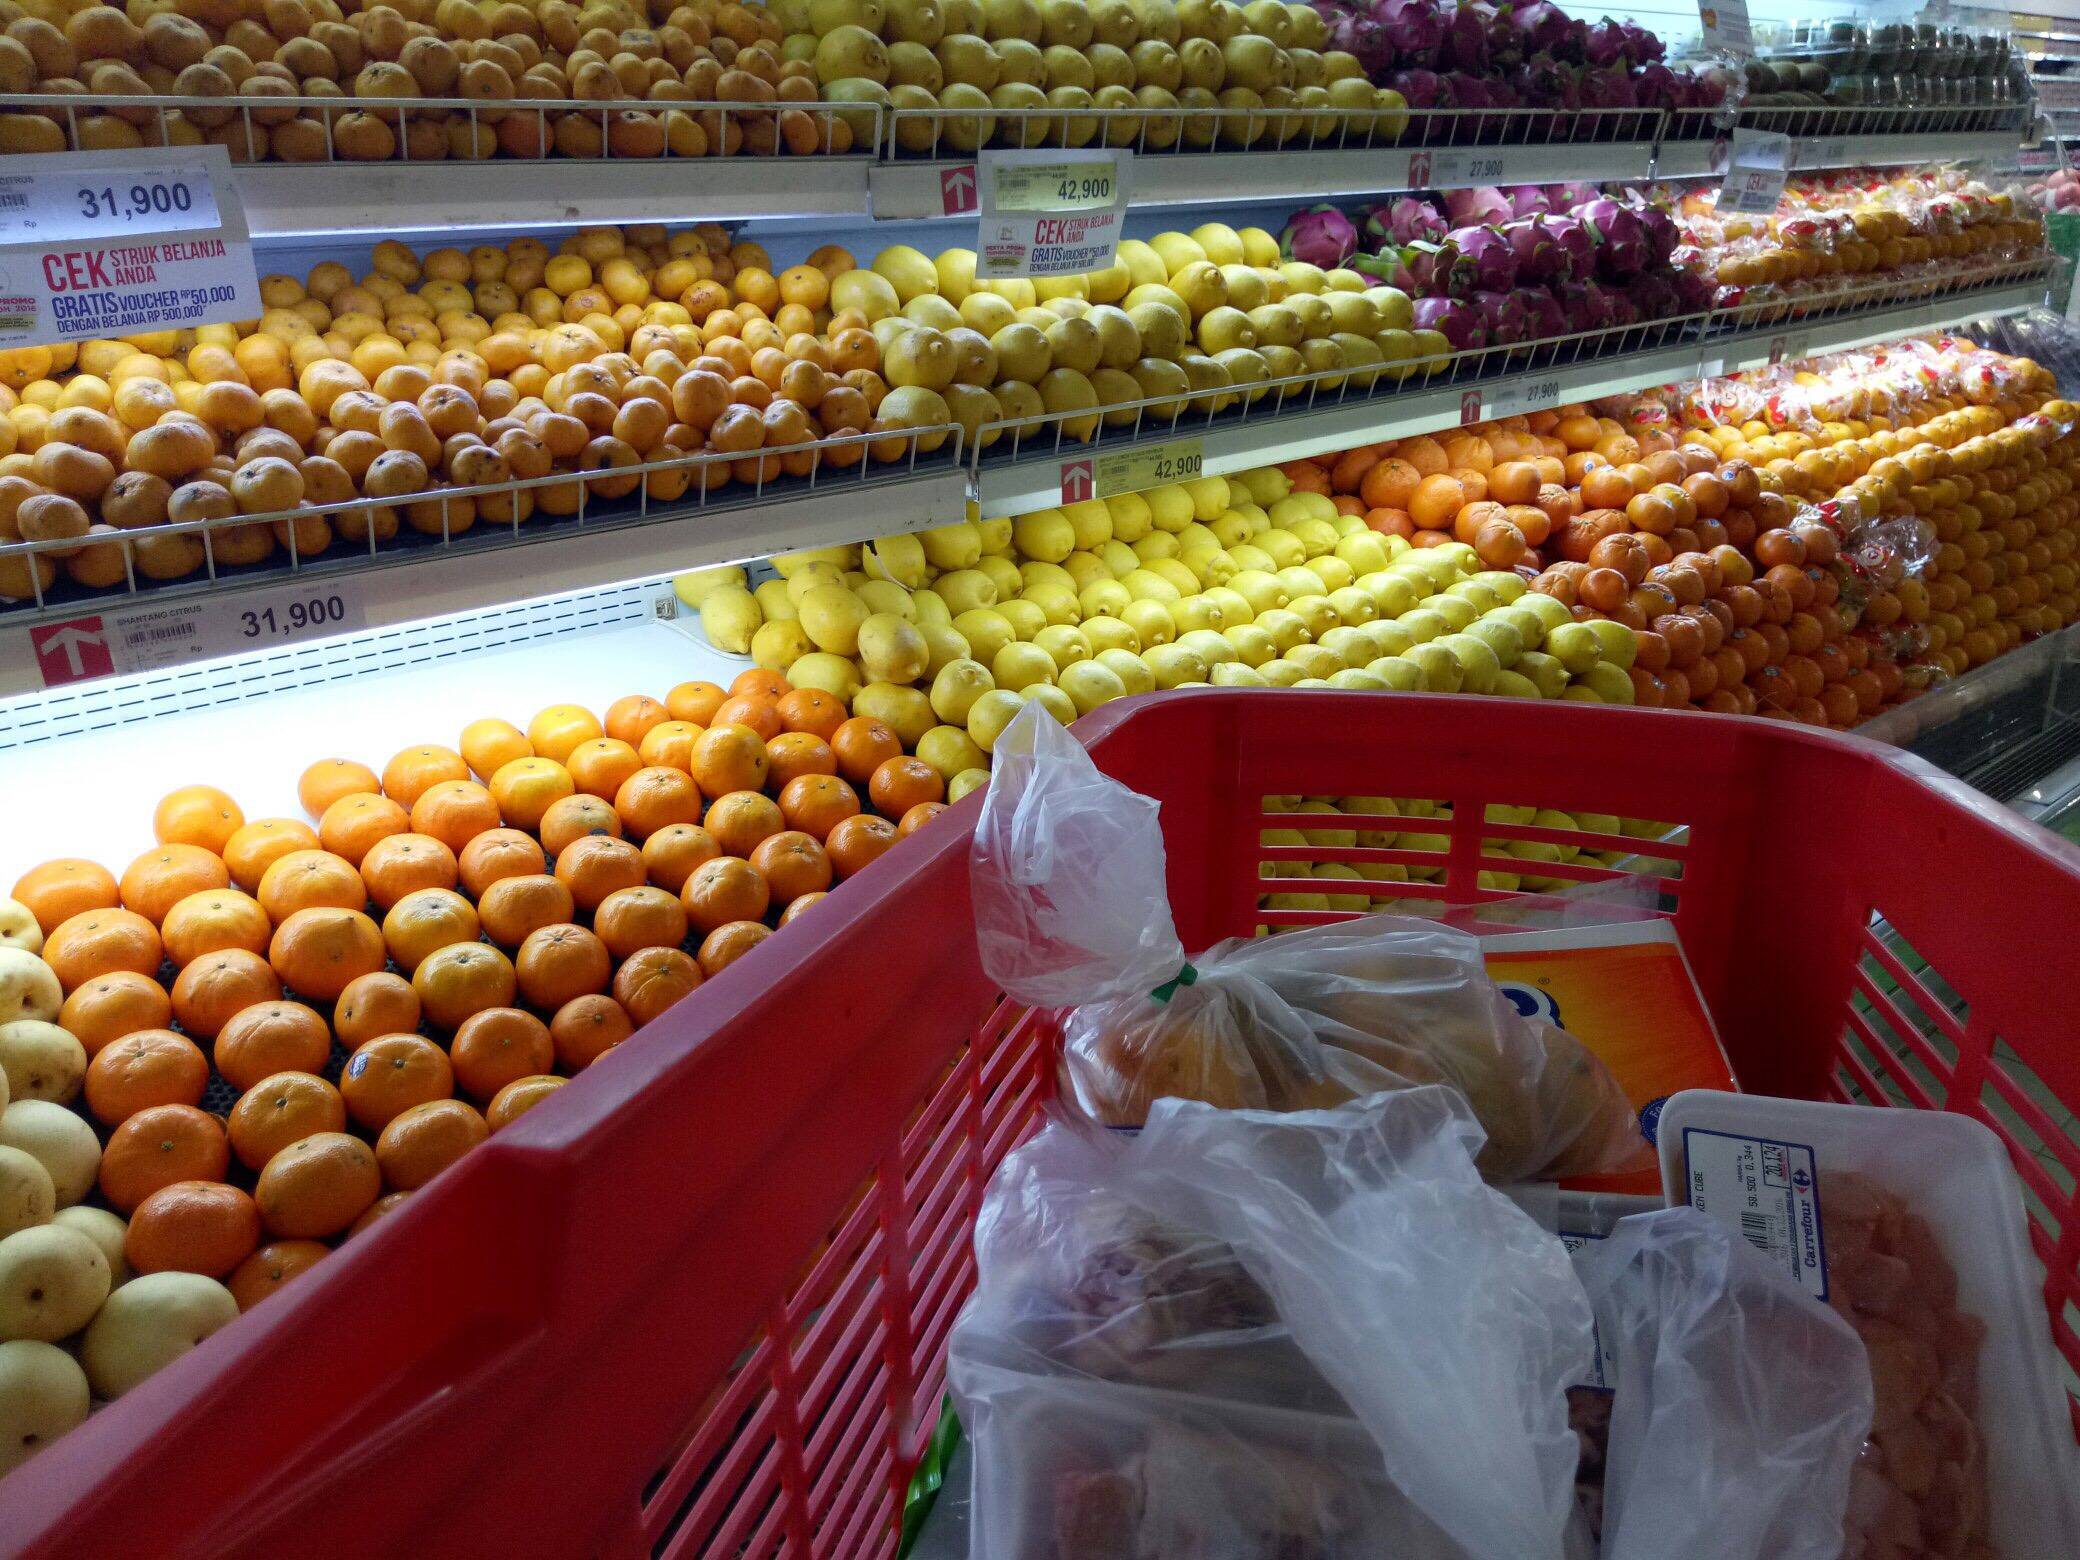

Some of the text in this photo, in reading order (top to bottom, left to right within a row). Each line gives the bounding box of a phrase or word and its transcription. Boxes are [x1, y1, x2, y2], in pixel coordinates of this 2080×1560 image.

[78, 182, 192, 221] 31,900
[1058, 178, 1109, 203] 42,900
[23, 220, 37, 230] Rp
[1035, 219, 1067, 245] CEK
[1068, 217, 1090, 231] STRUK
[1066, 231, 1085, 244] ANDA
[41, 239, 226, 293] CEK STRUK BELANJA
[1032, 247, 1063, 263] GRATIS
[115, 265, 157, 287] ANDA
[52, 291, 118, 320] GRATIS
[118, 290, 180, 313] VOUCHER
[56, 317, 101, 334] DENGAN
[102, 314, 146, 330] BELANJA
[147, 311, 161, 324] RP
[1527, 382, 1559, 402] 27,900
[1154, 454, 1203, 480] 42,900
[169, 605, 202, 617] CITRUS
[240, 595, 345, 639] 31,900
[190, 645, 203, 653] Rp
[1694, 1170, 1705, 1192] CUBE
[1801, 1199, 1817, 1268] Carrefour
